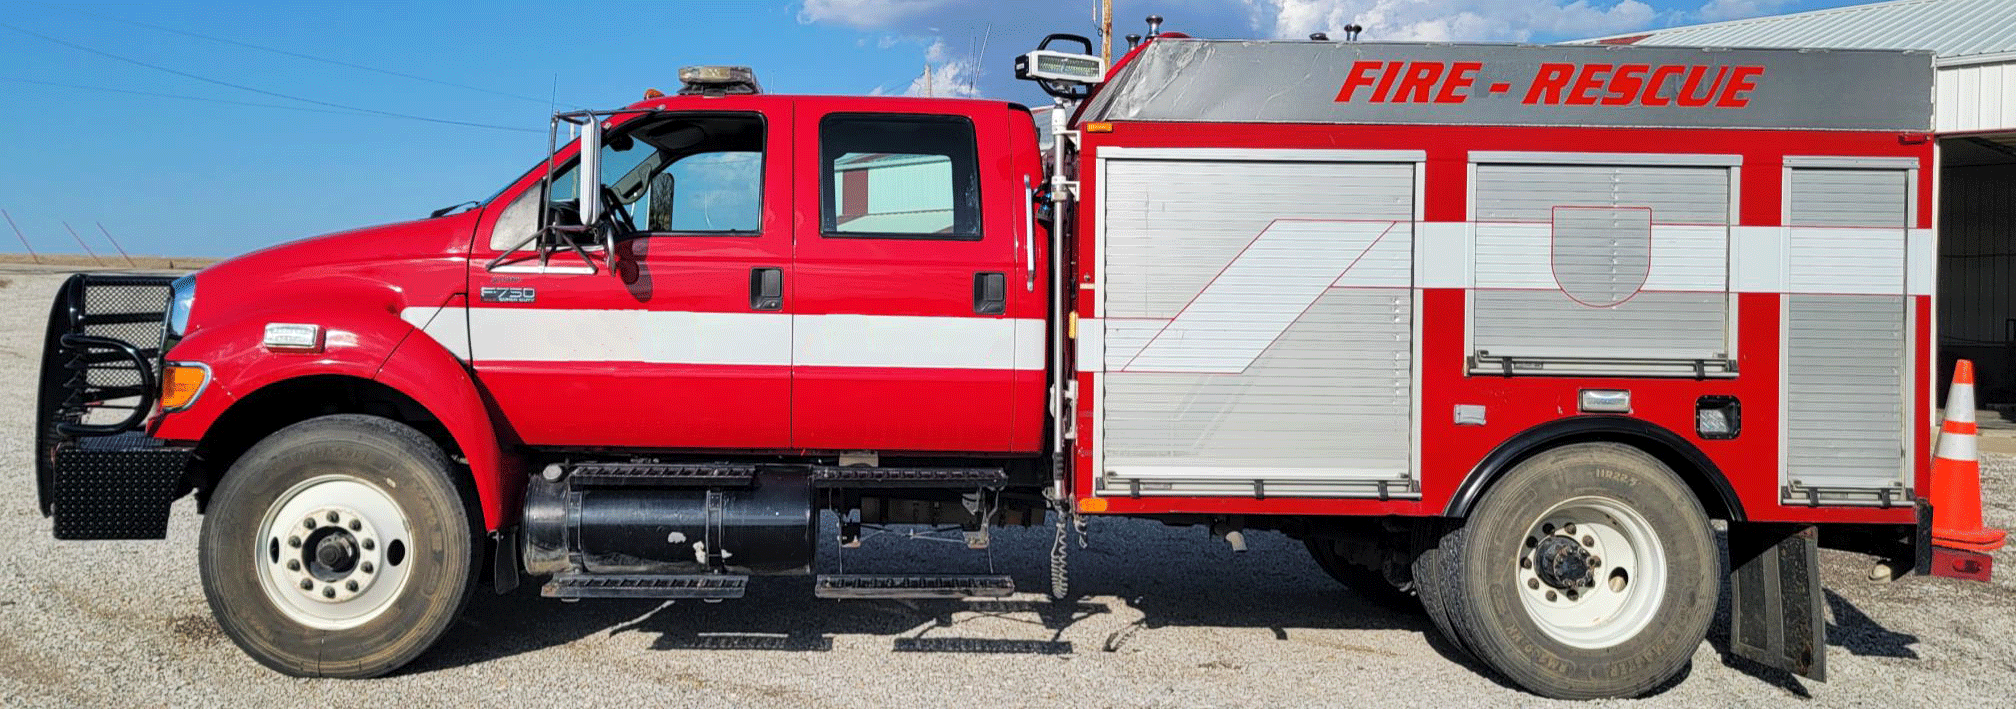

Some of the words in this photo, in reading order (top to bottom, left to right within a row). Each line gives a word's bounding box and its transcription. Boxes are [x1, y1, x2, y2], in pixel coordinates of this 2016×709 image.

[1334, 61, 1483, 103] FIRE
[1488, 82, 1510, 93] -
[1521, 63, 1765, 108] RESCUE
